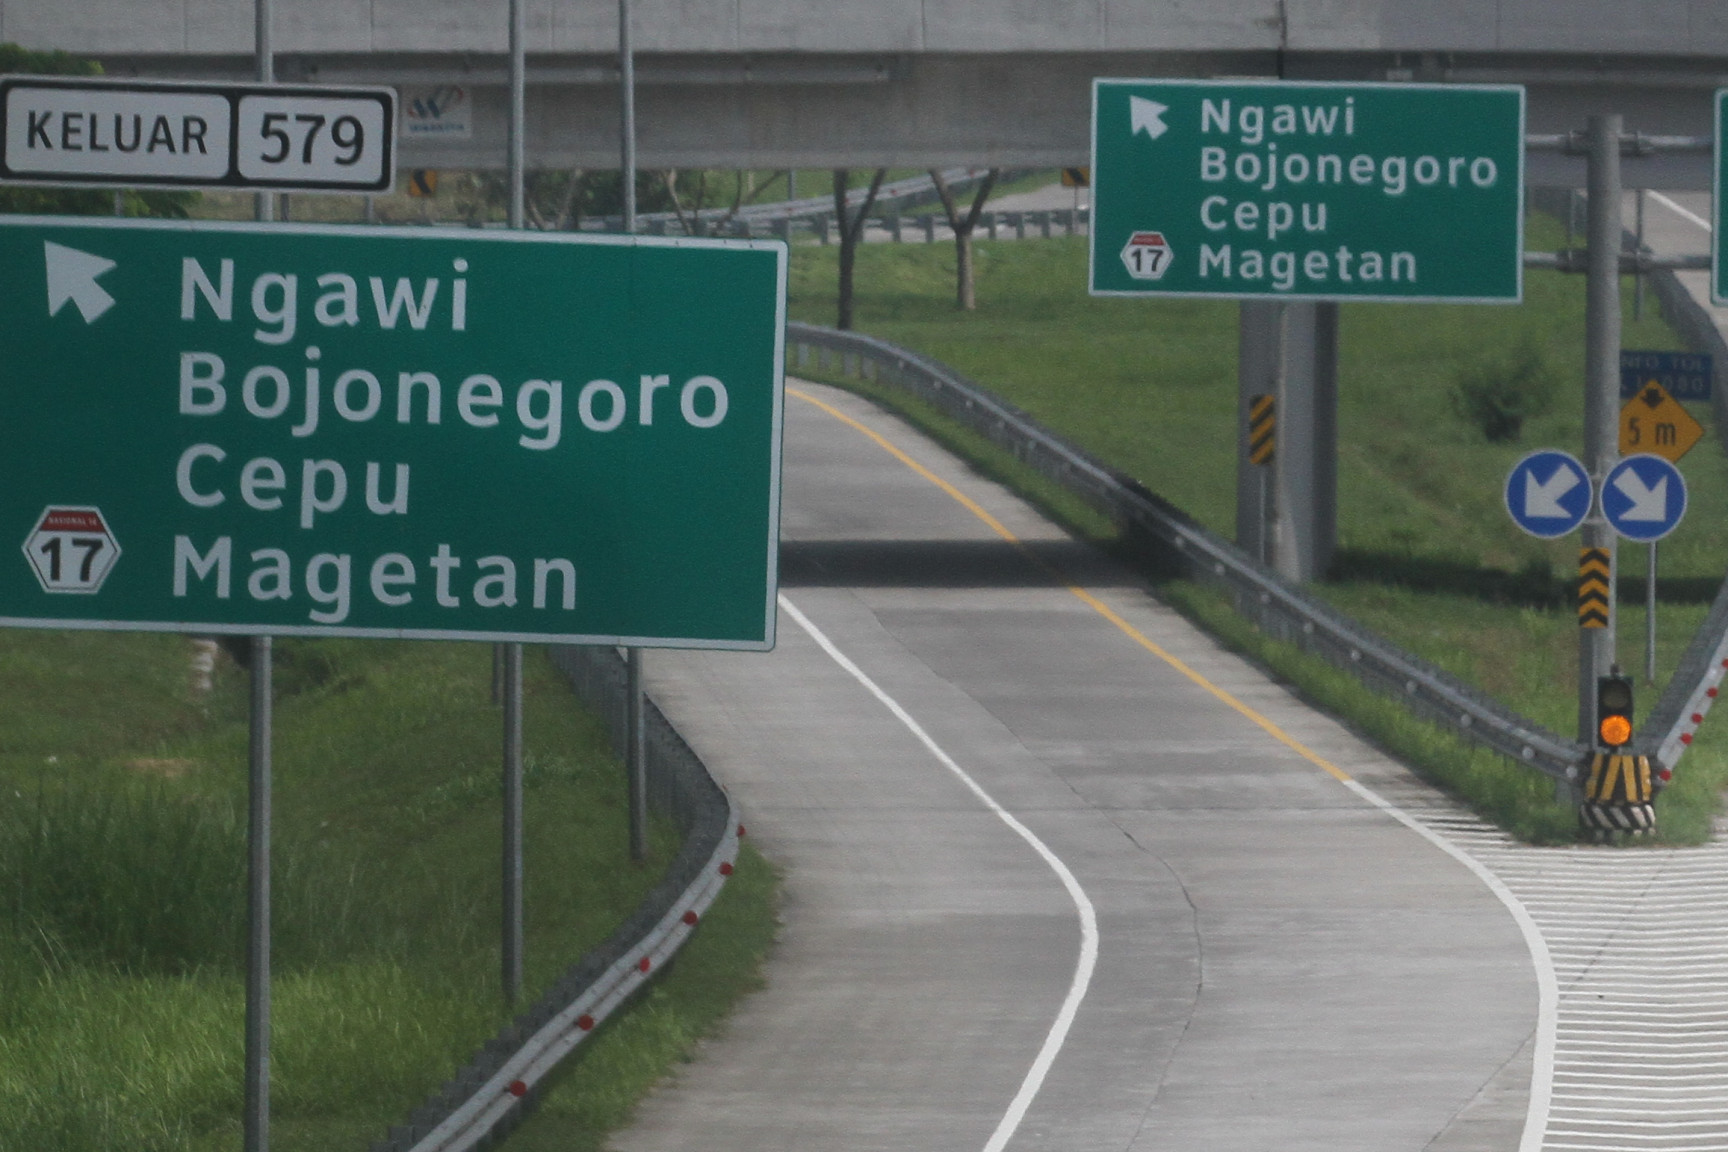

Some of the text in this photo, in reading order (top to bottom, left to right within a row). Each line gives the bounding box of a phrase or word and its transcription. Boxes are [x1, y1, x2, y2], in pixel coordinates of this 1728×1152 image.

[26, 110, 366, 166] KELUAR 579
[1200, 97, 1355, 144] Ngawi
[1200, 143, 1497, 195] Bojonegoro
[1200, 195, 1327, 239] Cepu
[1131, 248, 1164, 273] 17
[1199, 243, 1417, 290] Magetan
[180, 256, 469, 345] Ngawi
[178, 346, 730, 450] Bojonegoro
[1628, 417, 1676, 446] 5 m
[175, 443, 411, 530] Cepu
[41, 537, 104, 582] 17
[173, 535, 578, 624] Magetan
